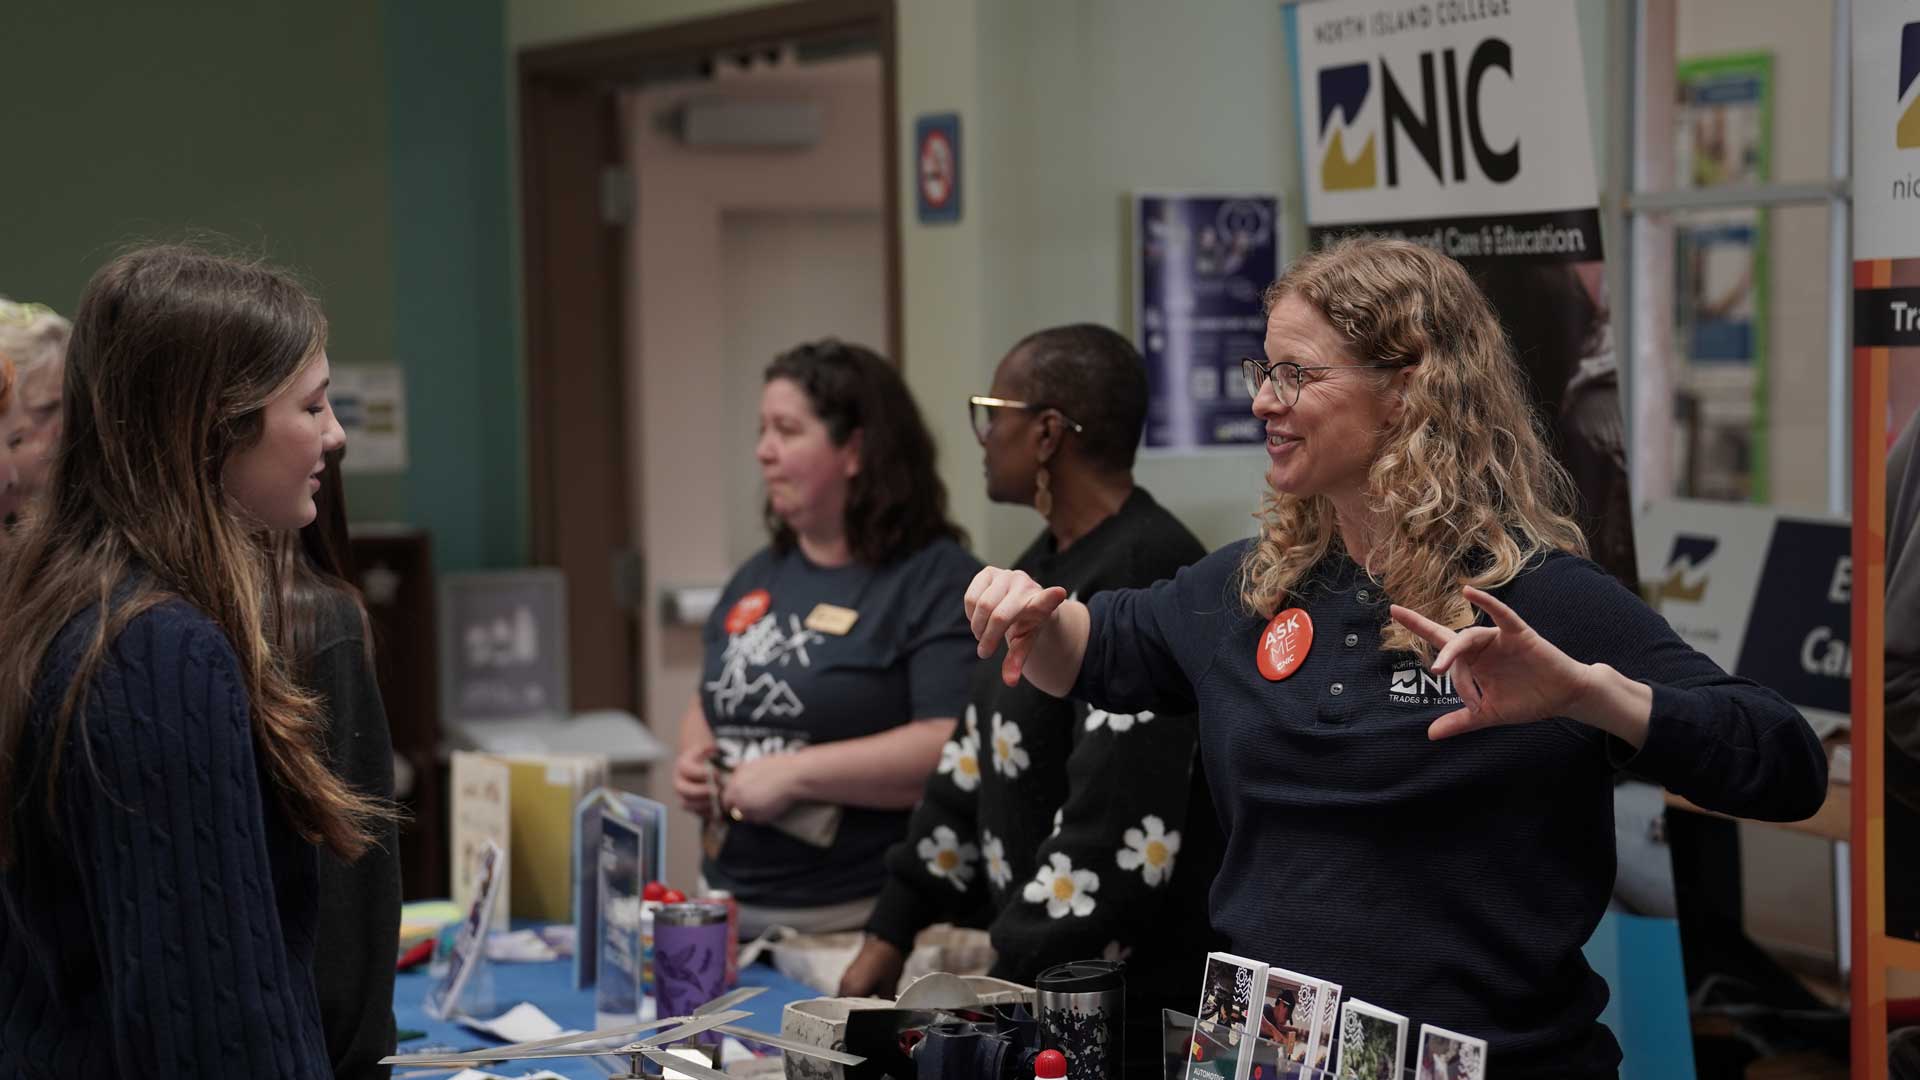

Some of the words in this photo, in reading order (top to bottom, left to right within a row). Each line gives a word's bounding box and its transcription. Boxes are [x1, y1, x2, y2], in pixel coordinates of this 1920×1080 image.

[1313, 17, 1364, 44] NORTH
[1369, 4, 1431, 37] ISLAND
[1436, 0, 1511, 26] COLLEGE
[1379, 37, 1520, 187] NIC
[1493, 223, 1587, 255] Education
[1264, 613, 1300, 650] ASK
[1270, 633, 1297, 664] ME
[1420, 668, 1451, 696] NI
[1389, 694, 1420, 704] TRADES
[1422, 696, 1429, 704] &
[1433, 696, 1465, 705] TECHNIC
